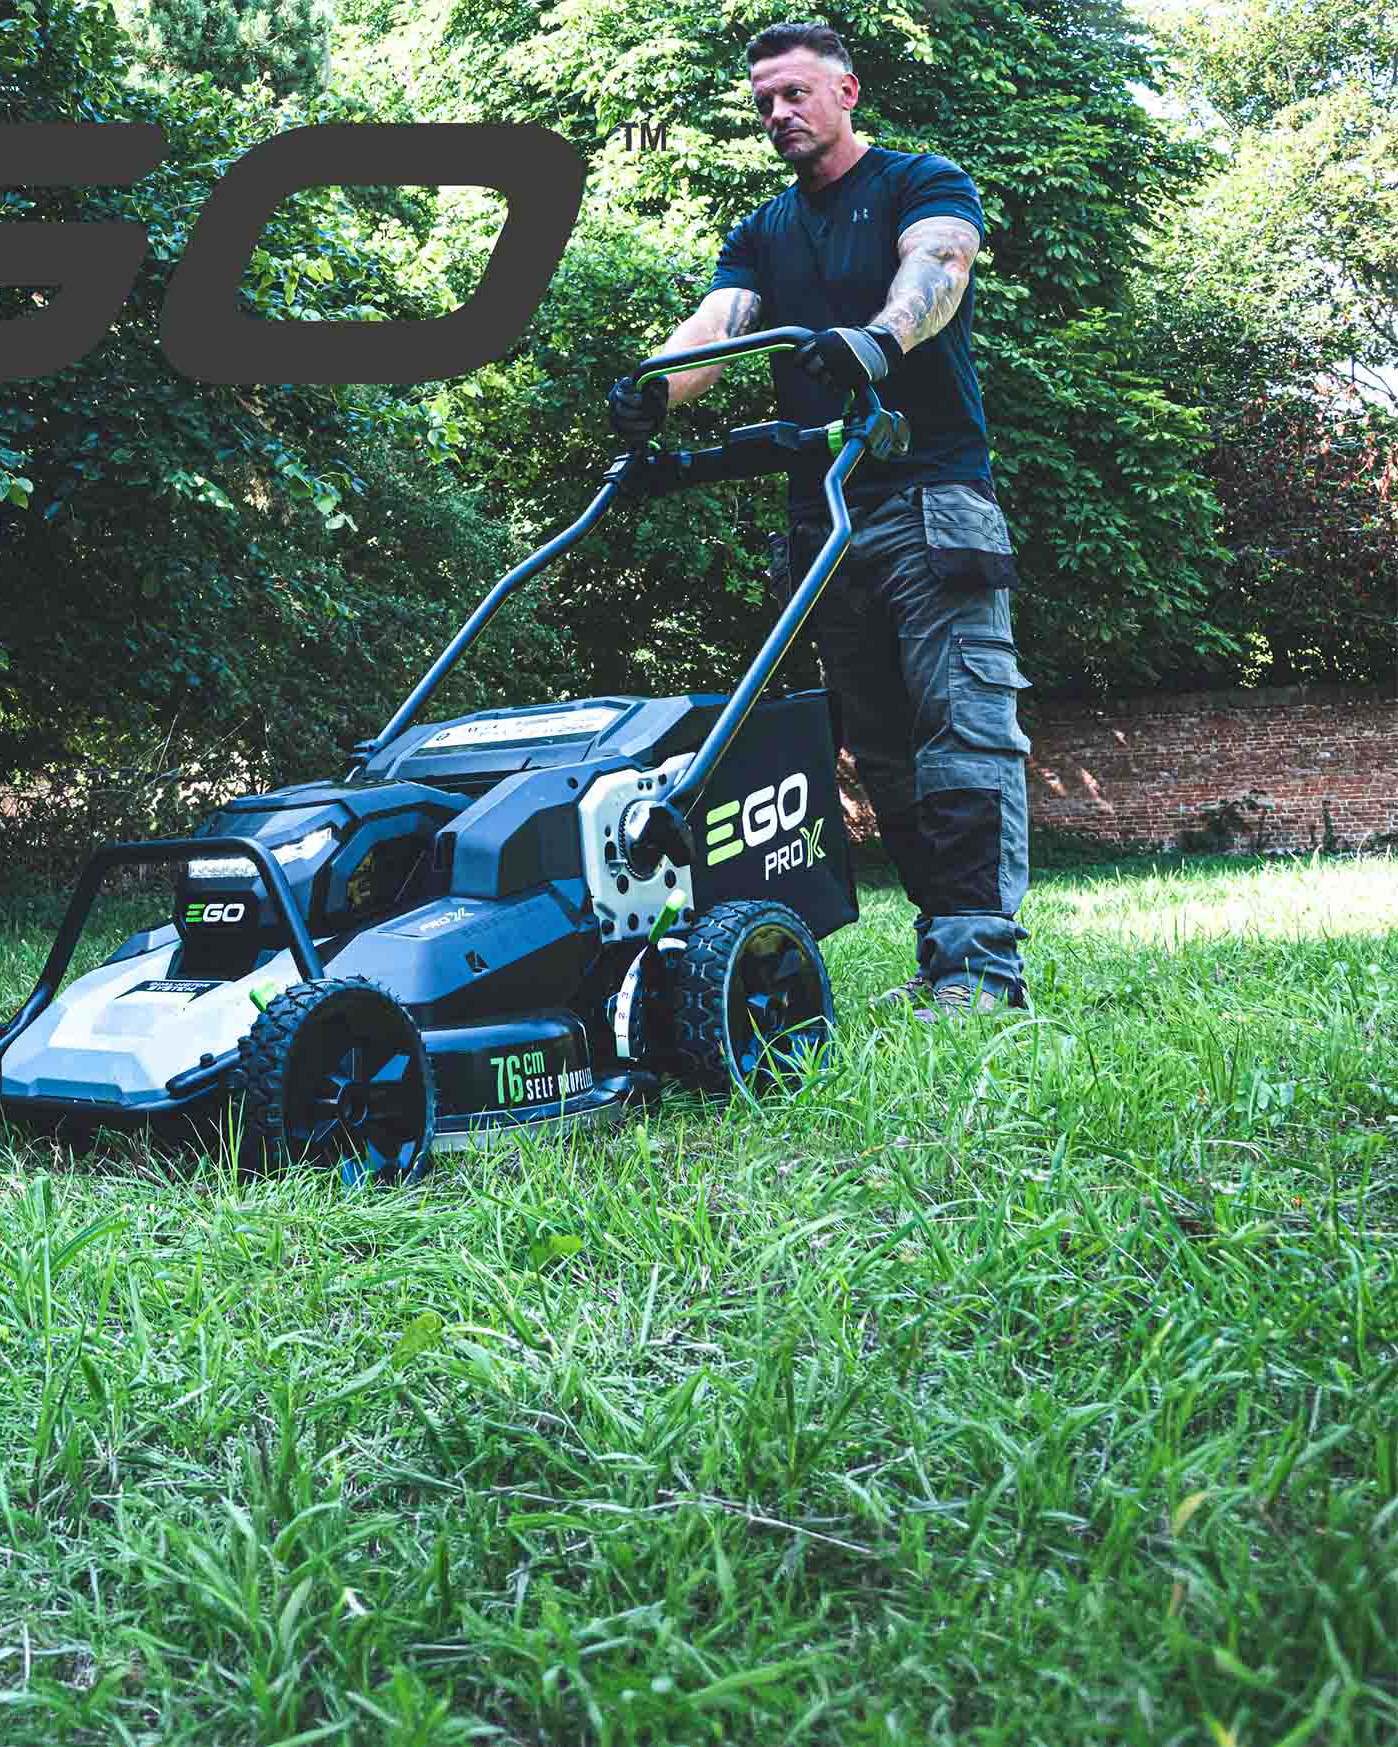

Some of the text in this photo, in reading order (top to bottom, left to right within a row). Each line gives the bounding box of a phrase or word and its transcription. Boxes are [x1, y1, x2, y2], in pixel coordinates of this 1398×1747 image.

[706, 772, 808, 867] EGO
[185, 903, 246, 923] EGO
[489, 1050, 546, 1105] 76 cm
[525, 1075, 555, 1101] SELF
